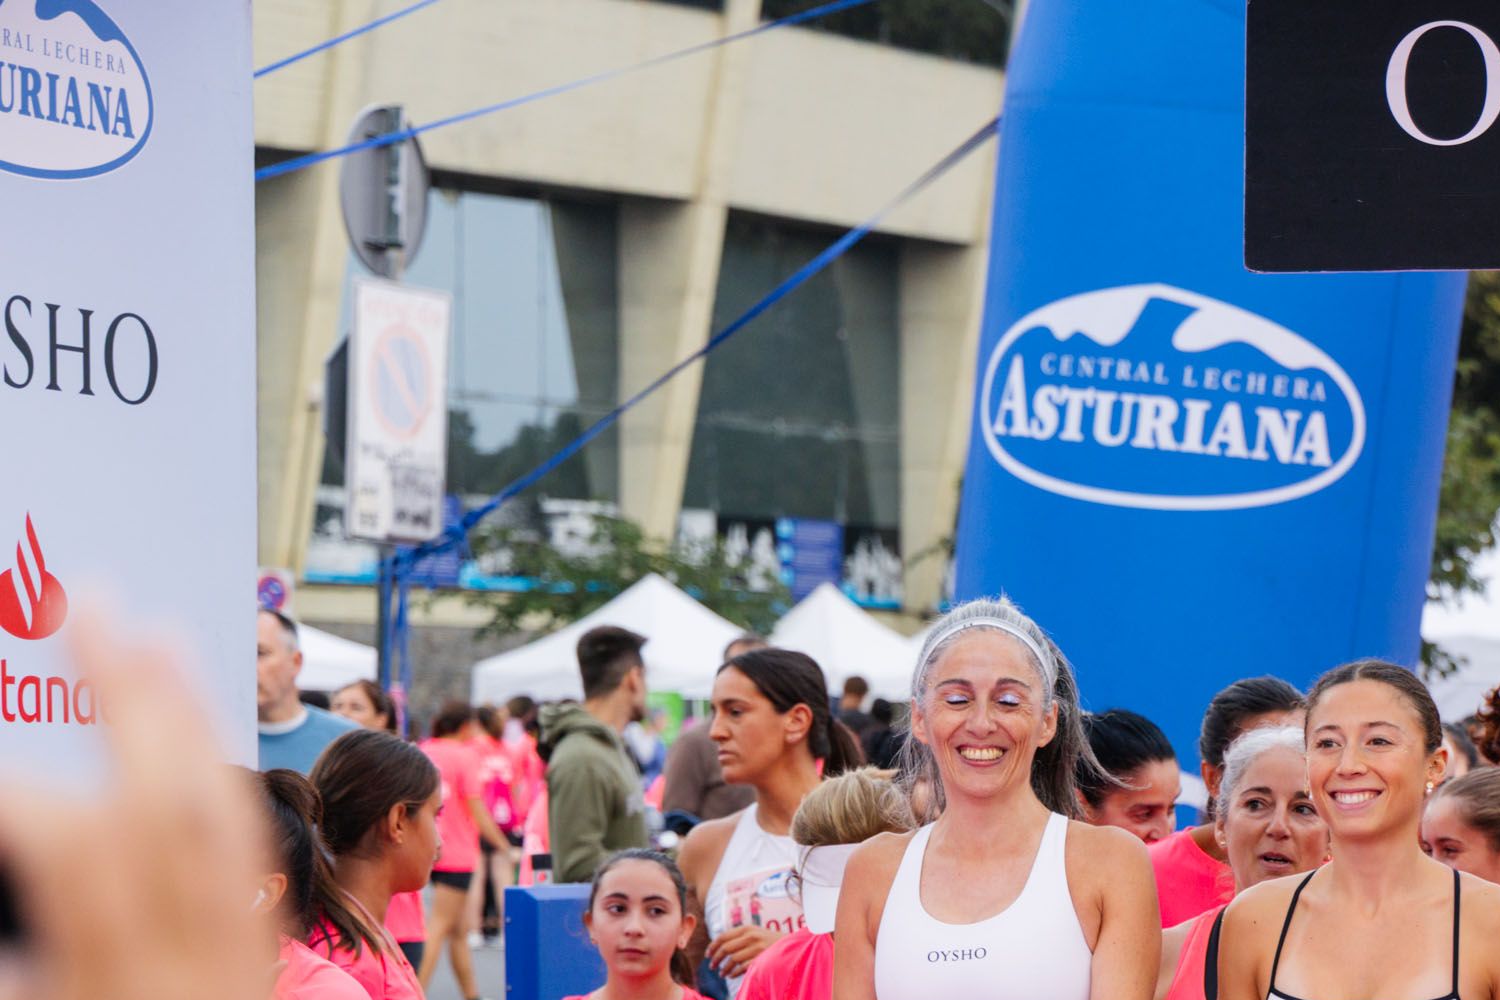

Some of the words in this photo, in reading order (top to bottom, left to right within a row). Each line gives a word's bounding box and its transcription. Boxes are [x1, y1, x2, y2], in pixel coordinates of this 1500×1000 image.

[43, 38, 127, 75] LECHERA
[1040, 353, 1169, 386] CENTRAL
[1183, 366, 1327, 402] LECHERA
[994, 354, 1332, 467] ASTURIANA
[927, 947, 988, 964] OYSHO
